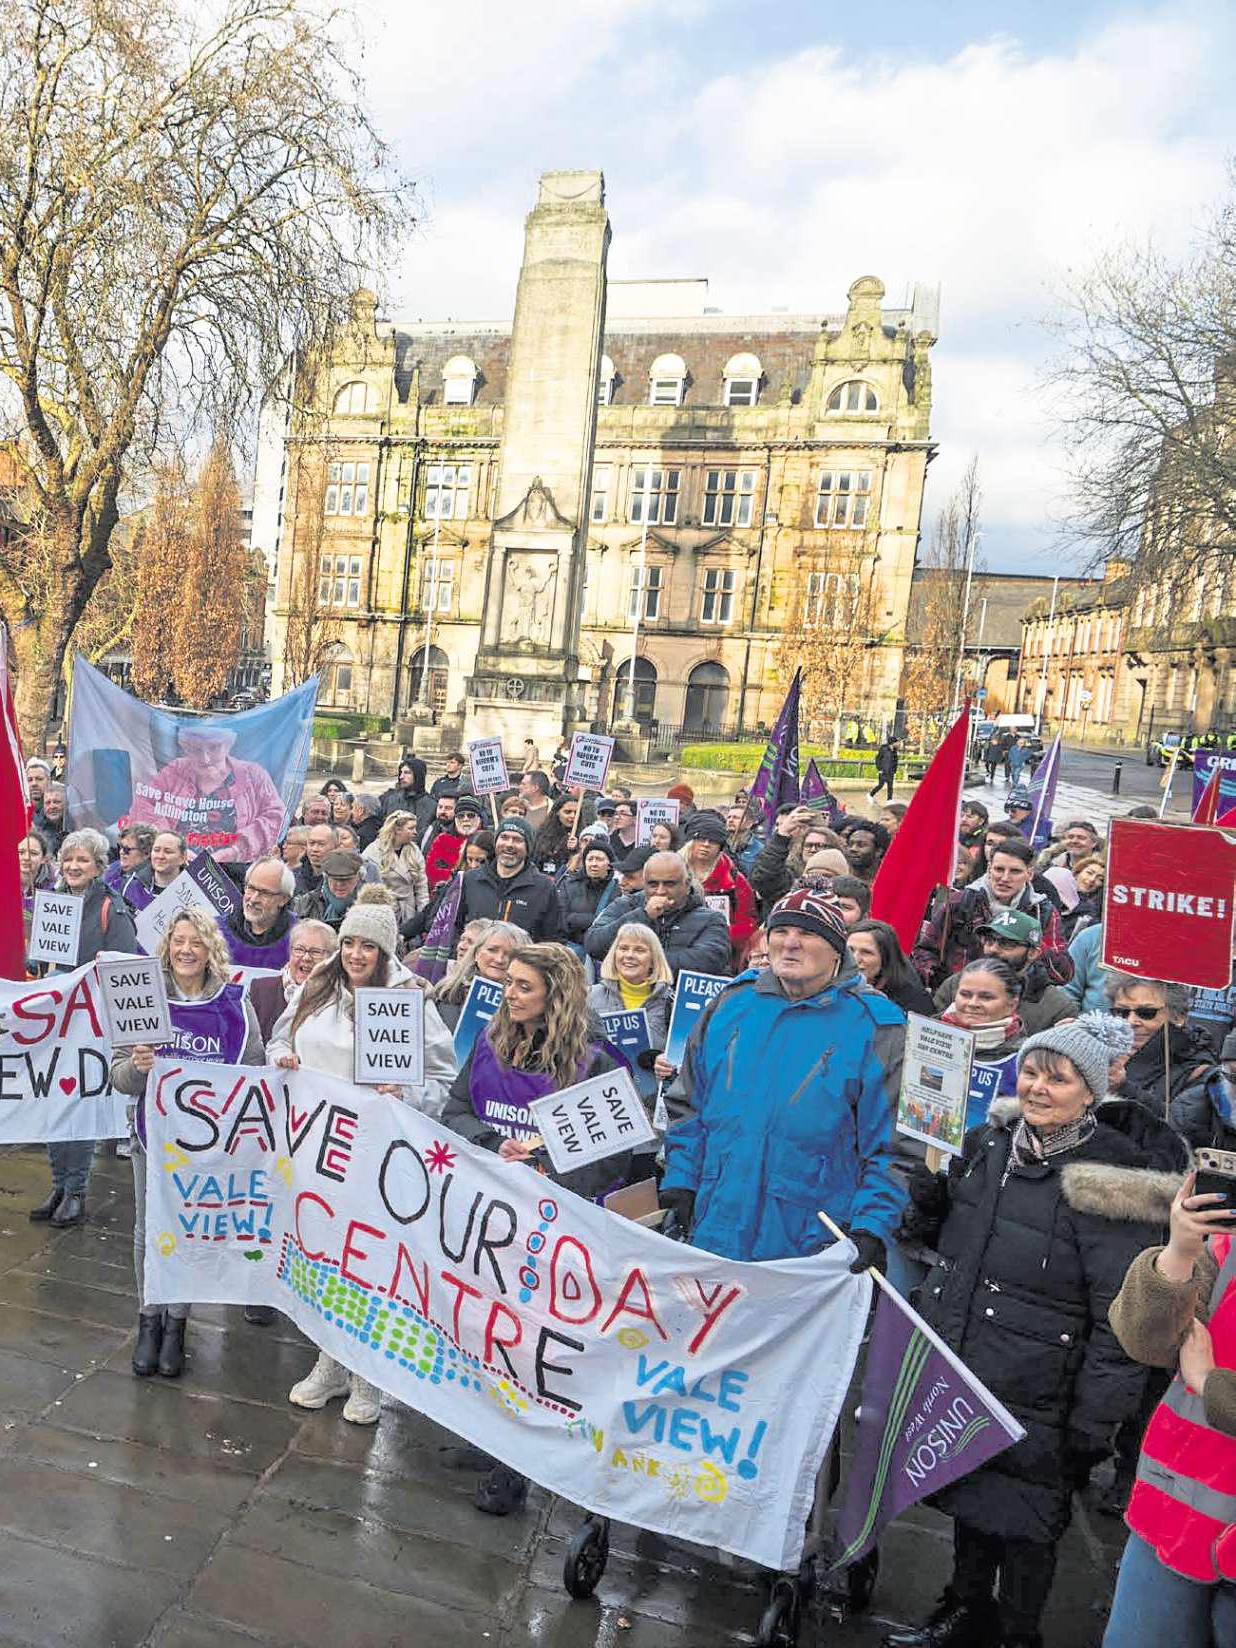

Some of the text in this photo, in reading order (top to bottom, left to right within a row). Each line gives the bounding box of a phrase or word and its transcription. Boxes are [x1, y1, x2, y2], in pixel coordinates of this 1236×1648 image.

[198, 797, 235, 812] House
[43, 901, 75, 917] SAVE
[1112, 884, 1227, 920] STRIKE!
[41, 921, 72, 936] VALE
[38, 938, 71, 953] VIEW
[109, 972, 152, 988] SAVE
[683, 976, 726, 1000] PLEAS
[114, 994, 155, 1010] VALE
[476, 985, 503, 1007] PLE
[367, 1002, 411, 1018] SAVE
[116, 1016, 160, 1033] VIEW
[623, 1014, 640, 1031] US
[368, 1028, 411, 1045] VALE
[366, 1052, 413, 1069] VIEW
[978, 1070, 994, 1087] US
[576, 1096, 608, 1145] VALE
[602, 1085, 635, 1136] SAVE
[551, 1104, 583, 1154] VIEW
[173, 1169, 268, 1201] VALE
[173, 1076, 741, 1355] SAVE OUR DAY
[178, 1203, 274, 1240] VIEW!
[294, 1190, 584, 1412] CENTRE
[635, 1353, 750, 1413] VALE
[905, 1375, 951, 1442] North West
[622, 1399, 768, 1481] VIEW!
[905, 1396, 974, 1488] UNISON
